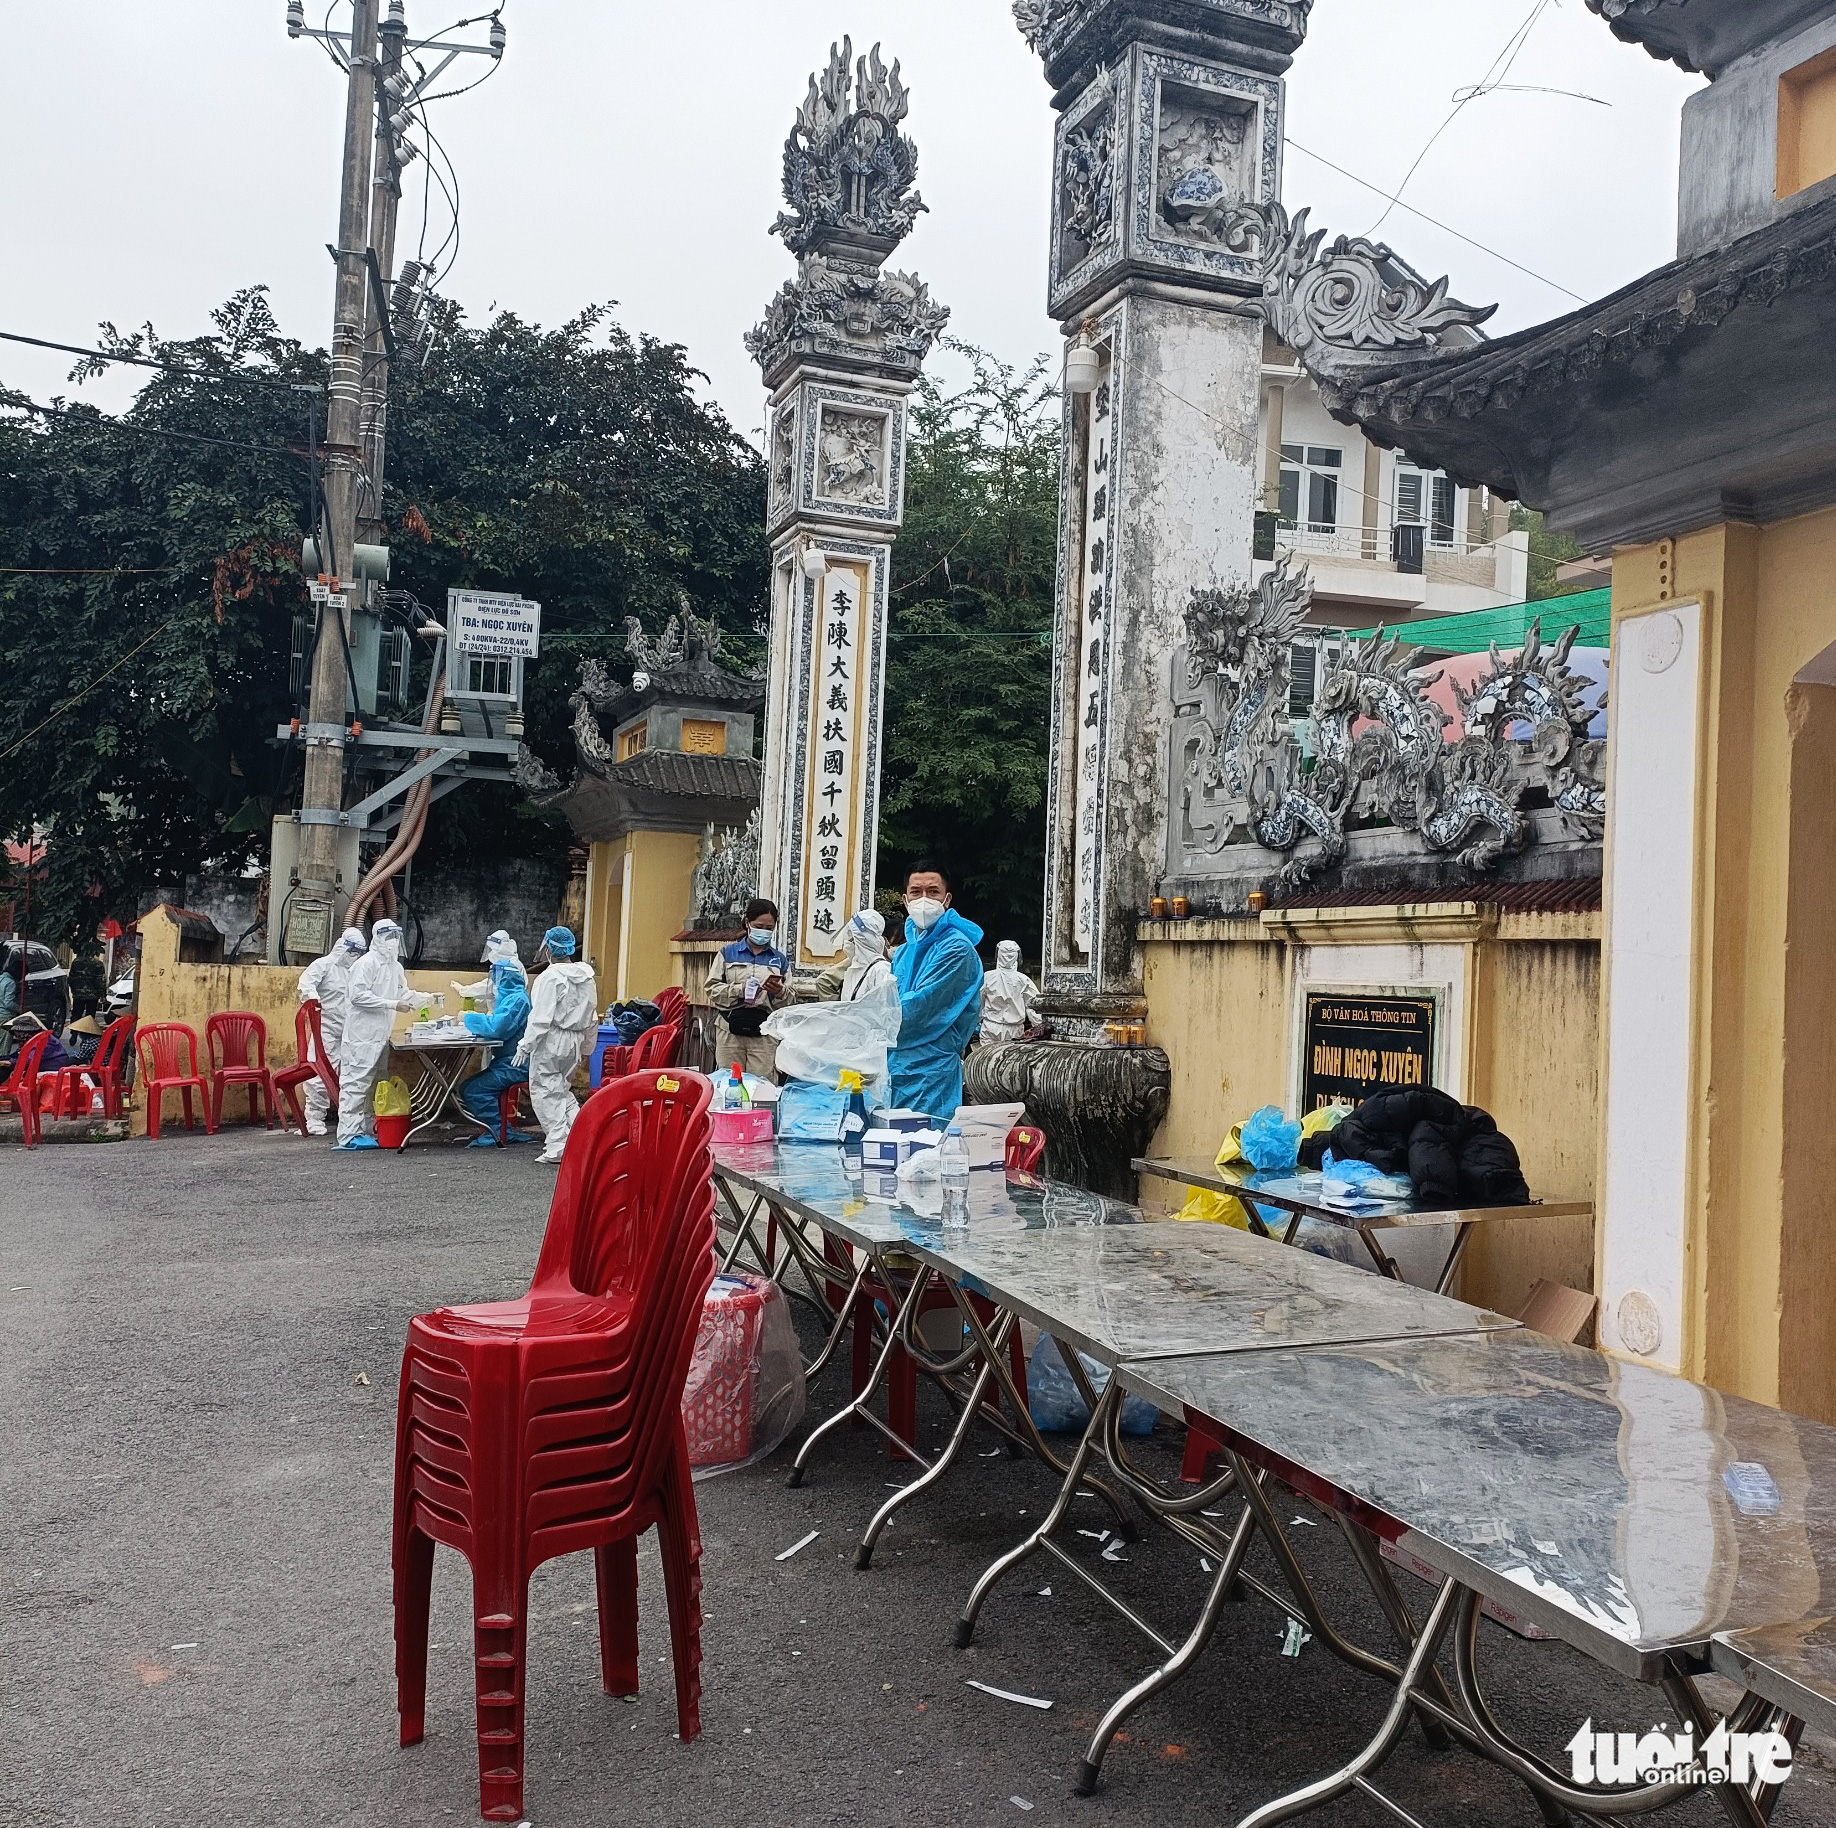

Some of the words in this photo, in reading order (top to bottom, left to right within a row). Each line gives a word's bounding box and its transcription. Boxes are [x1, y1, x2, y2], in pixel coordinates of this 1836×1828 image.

[461, 617, 480, 628] TBA:
[481, 618, 504, 631] NGỌC
[506, 620, 533, 633] XUYÊN
[463, 633, 471, 641] S:
[1321, 1005, 1332, 1022] BỘ
[1333, 1006, 1351, 1020] VĂN
[1351, 1007, 1369, 1021] HOÁ
[1371, 1007, 1400, 1023] THÔNG
[1401, 1012, 1417, 1024] TIN
[1313, 1039, 1342, 1077] ĐÌNH
[1343, 1047, 1377, 1087] NGỌC
[1379, 1046, 1423, 1085] XUYÊN
